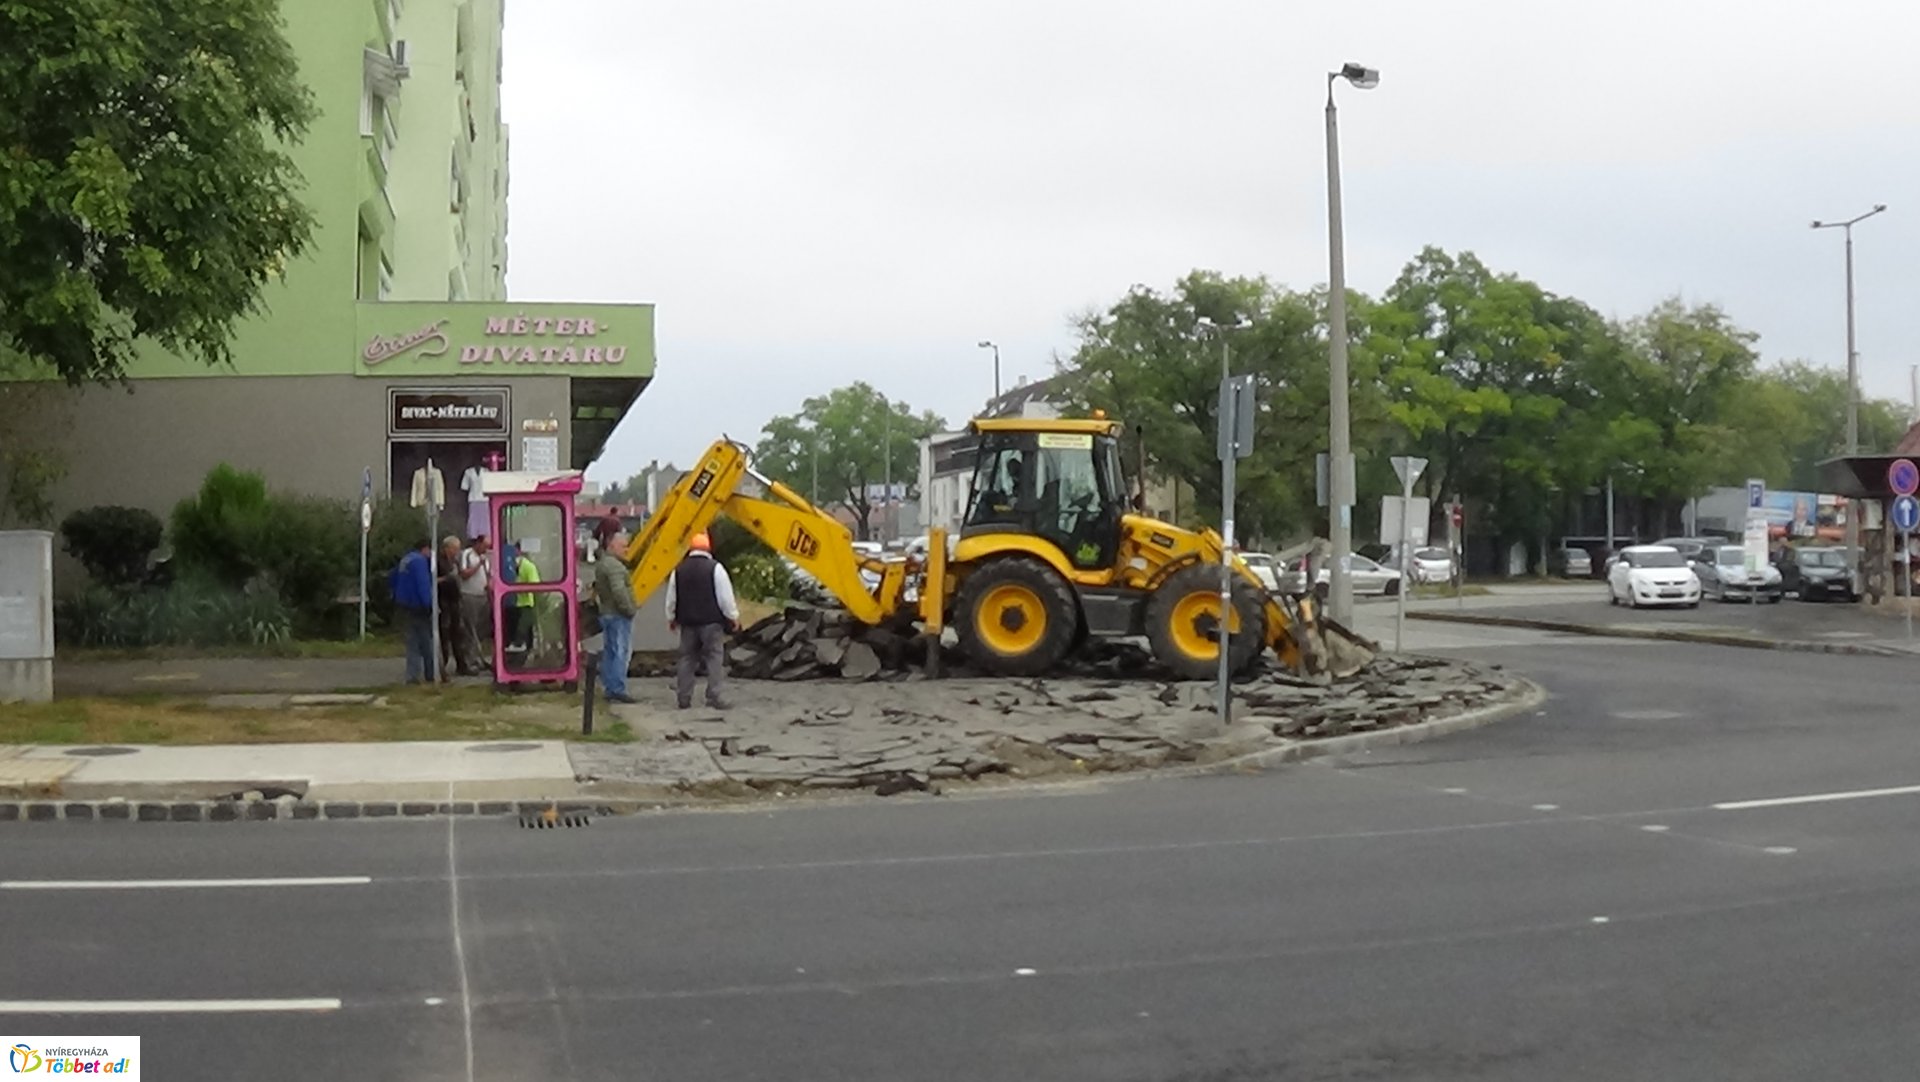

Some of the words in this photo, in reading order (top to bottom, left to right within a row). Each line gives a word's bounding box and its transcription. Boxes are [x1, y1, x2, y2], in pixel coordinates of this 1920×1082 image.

[484, 311, 609, 336] MÉTER-
[459, 339, 627, 365] DIVATÁRU
[401, 403, 498, 419] DIVAT-MÉTERÁRU
[789, 526, 818, 557] JCB
